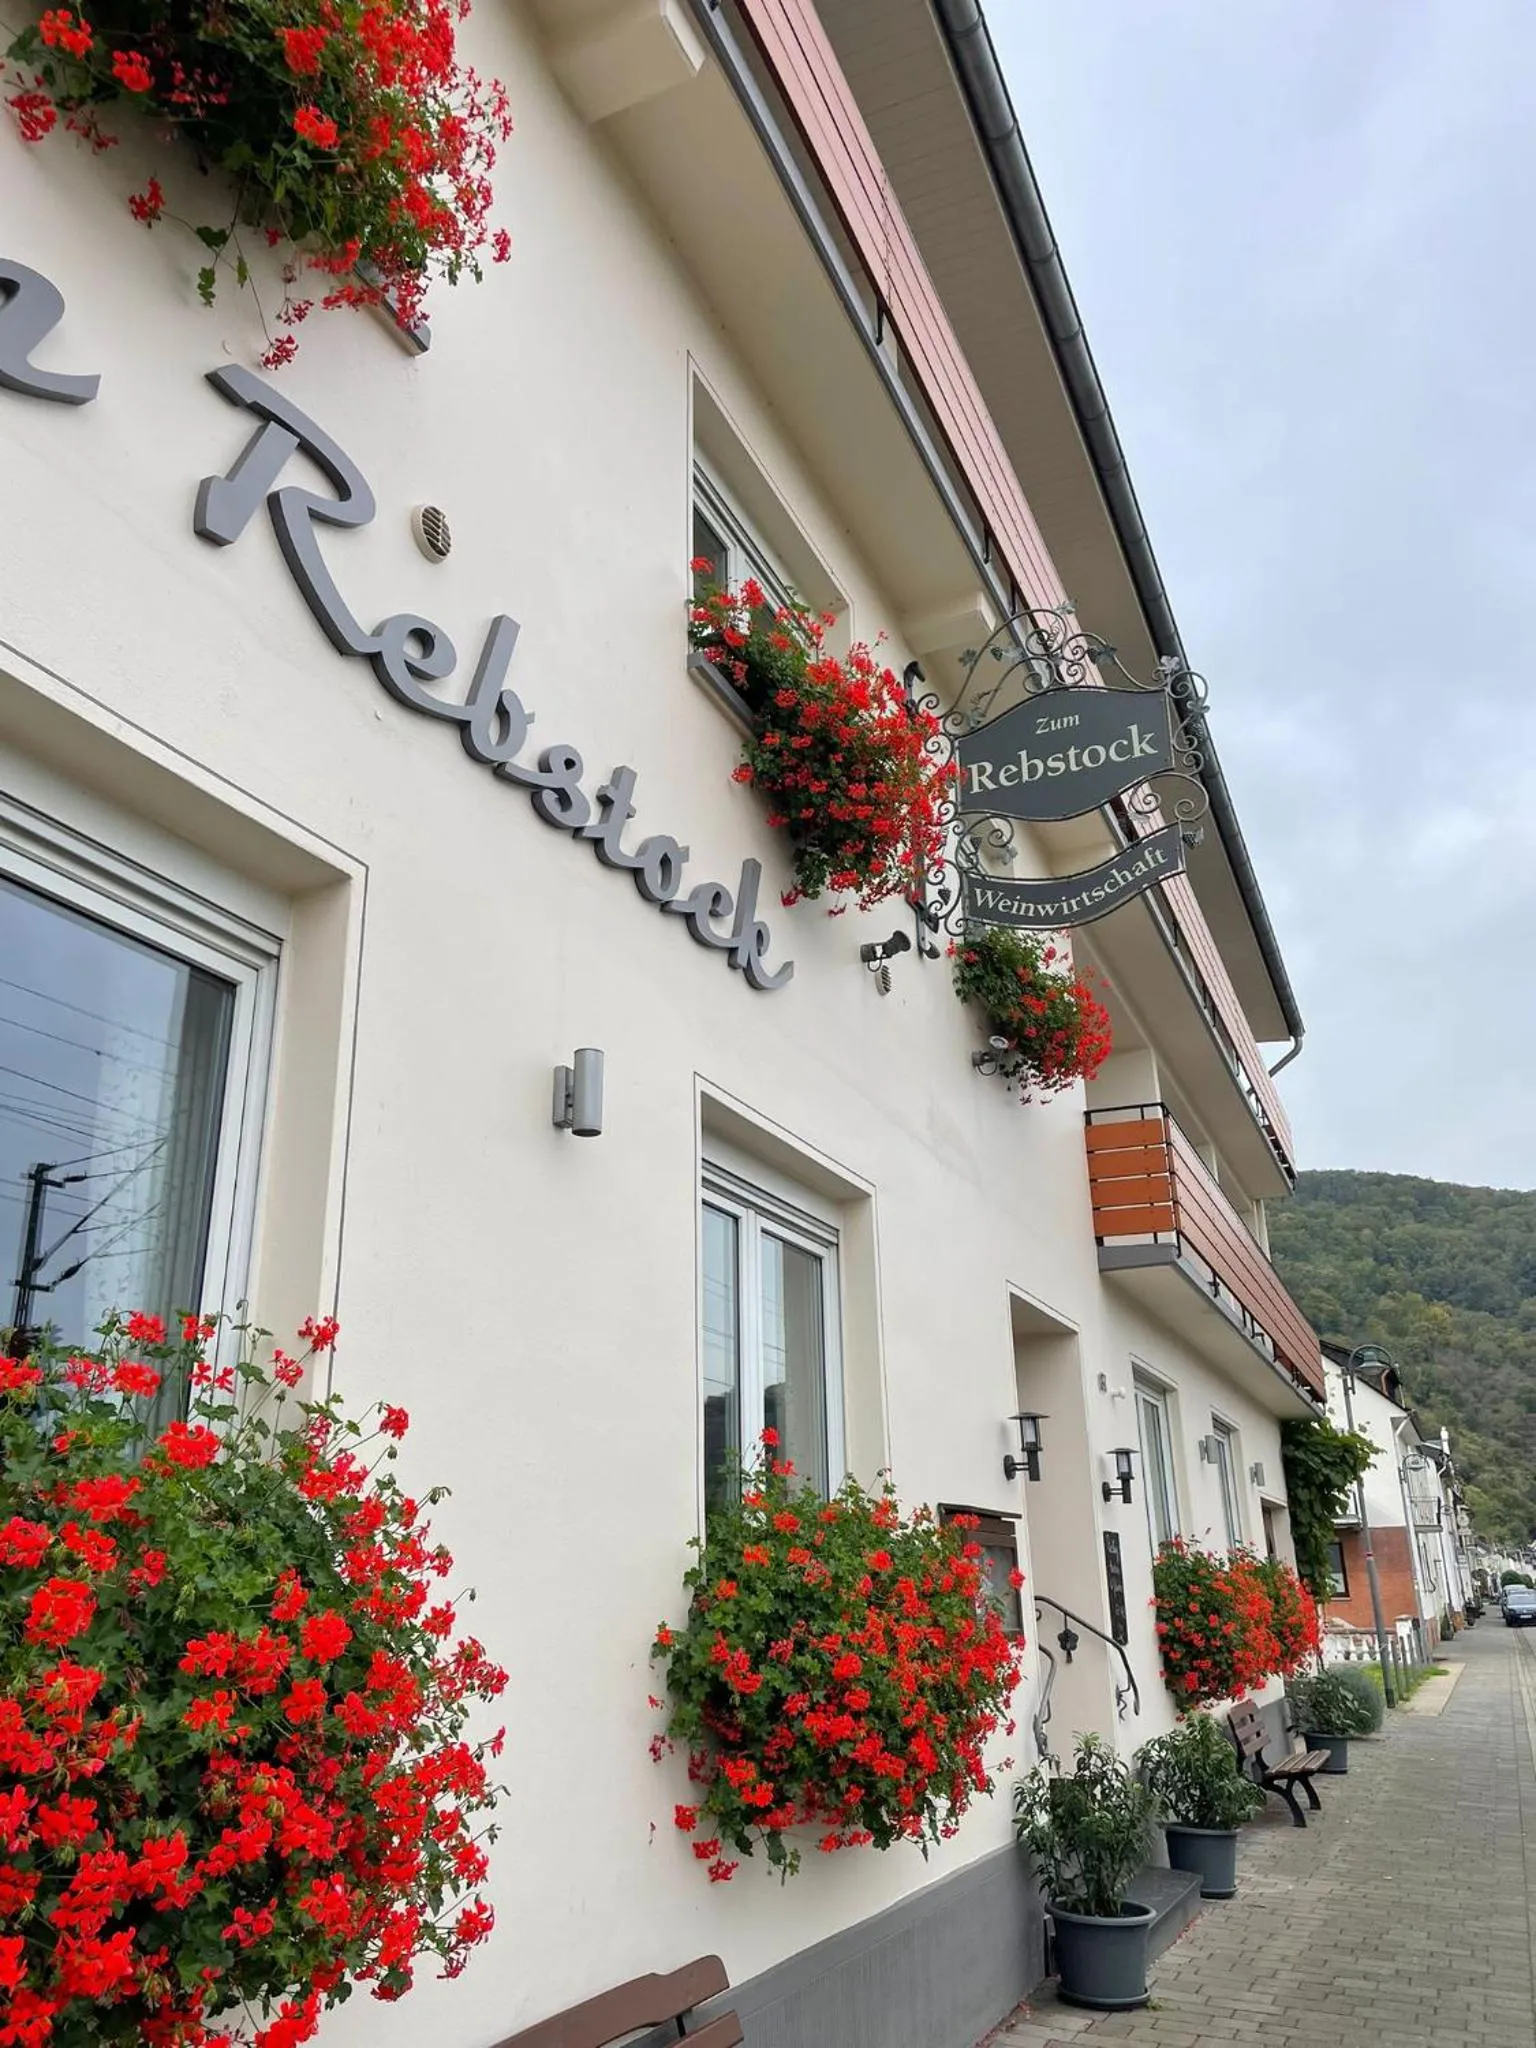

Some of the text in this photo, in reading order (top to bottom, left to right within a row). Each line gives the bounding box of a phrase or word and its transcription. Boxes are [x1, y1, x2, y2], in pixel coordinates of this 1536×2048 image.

[194, 363, 794, 990] Rebstock
[1035, 712, 1081, 735] Zum
[967, 724, 1158, 794] Rebstock
[974, 848, 1168, 917] Weinwirtschaft
